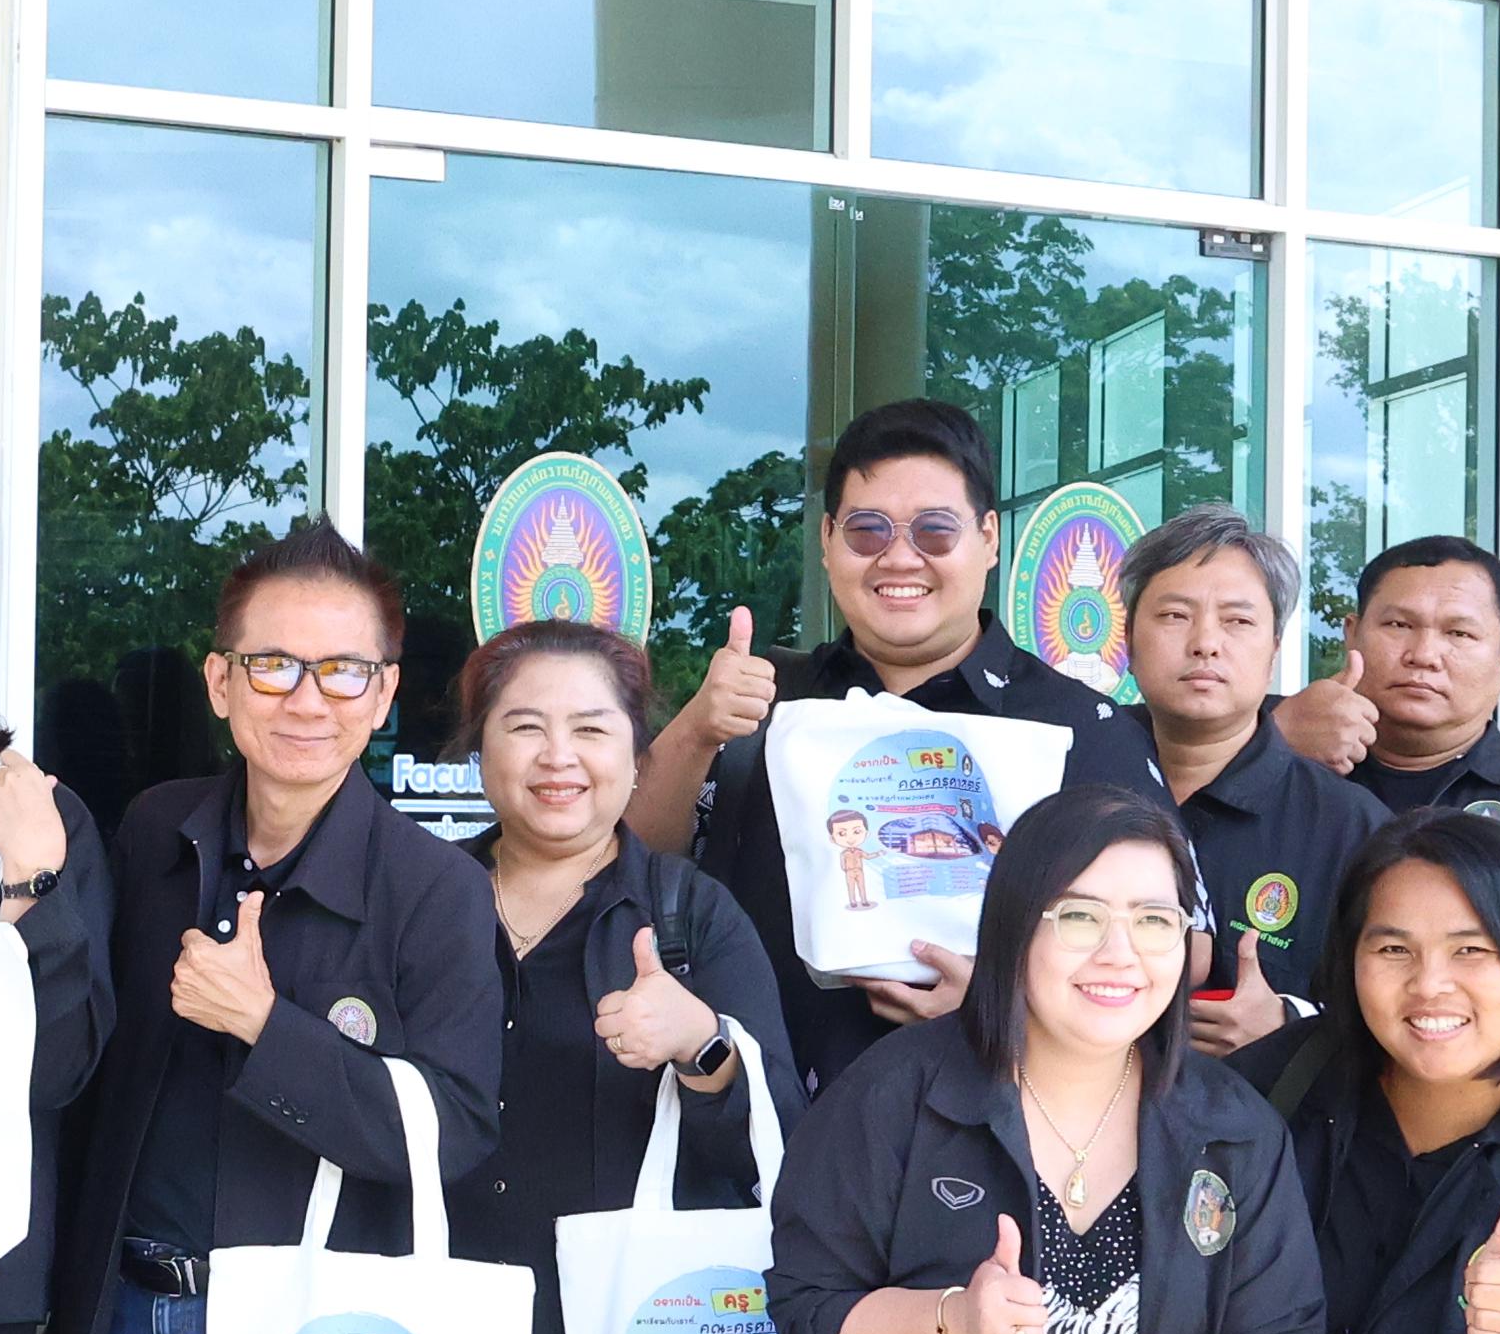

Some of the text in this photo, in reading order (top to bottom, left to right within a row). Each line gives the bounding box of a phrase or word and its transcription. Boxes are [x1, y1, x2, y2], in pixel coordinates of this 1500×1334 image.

[482, 570, 496, 630] KAMPH
[919, 751, 945, 769] ครู
[393, 754, 483, 793] Facul
[898, 777, 982, 793] คณะครุศาสตร์
[723, 1293, 750, 1313] ครู
